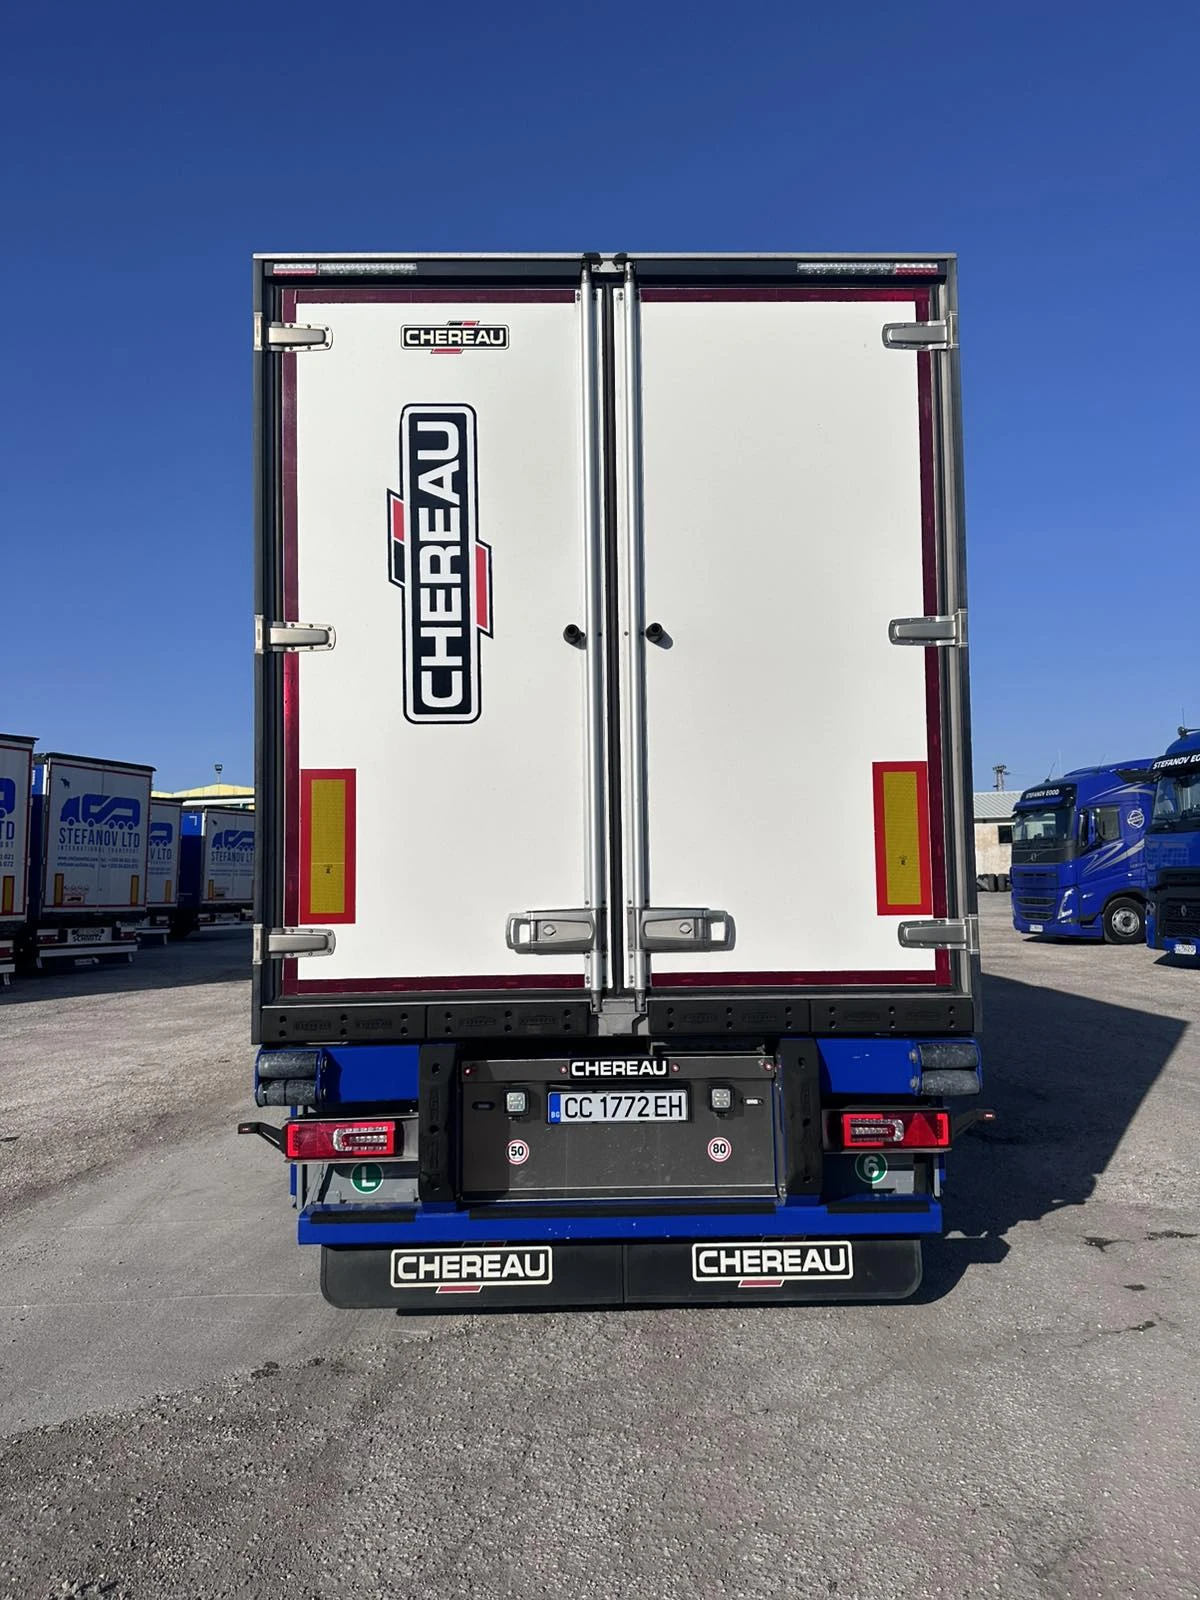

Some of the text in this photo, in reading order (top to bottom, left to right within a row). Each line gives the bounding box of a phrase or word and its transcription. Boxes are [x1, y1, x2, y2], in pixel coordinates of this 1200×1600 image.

[405, 329, 506, 346] CHEREAU
[417, 419, 464, 709] CHEREAU
[1152, 755, 1190, 770] STEFANOV
[59, 827, 140, 848] STEFANOV LTD
[157, 848, 172, 860] LTD
[571, 1060, 667, 1077] CHEREAU
[550, 1111, 561, 1119] BG
[564, 1095, 683, 1119] CC 1772 EH
[510, 1145, 525, 1157] 50
[712, 1143, 727, 1154] 80
[863, 1155, 880, 1178] 6
[361, 1166, 377, 1188] L
[396, 1255, 546, 1281] CHEREAU
[697, 1249, 846, 1275] CHEREAU
